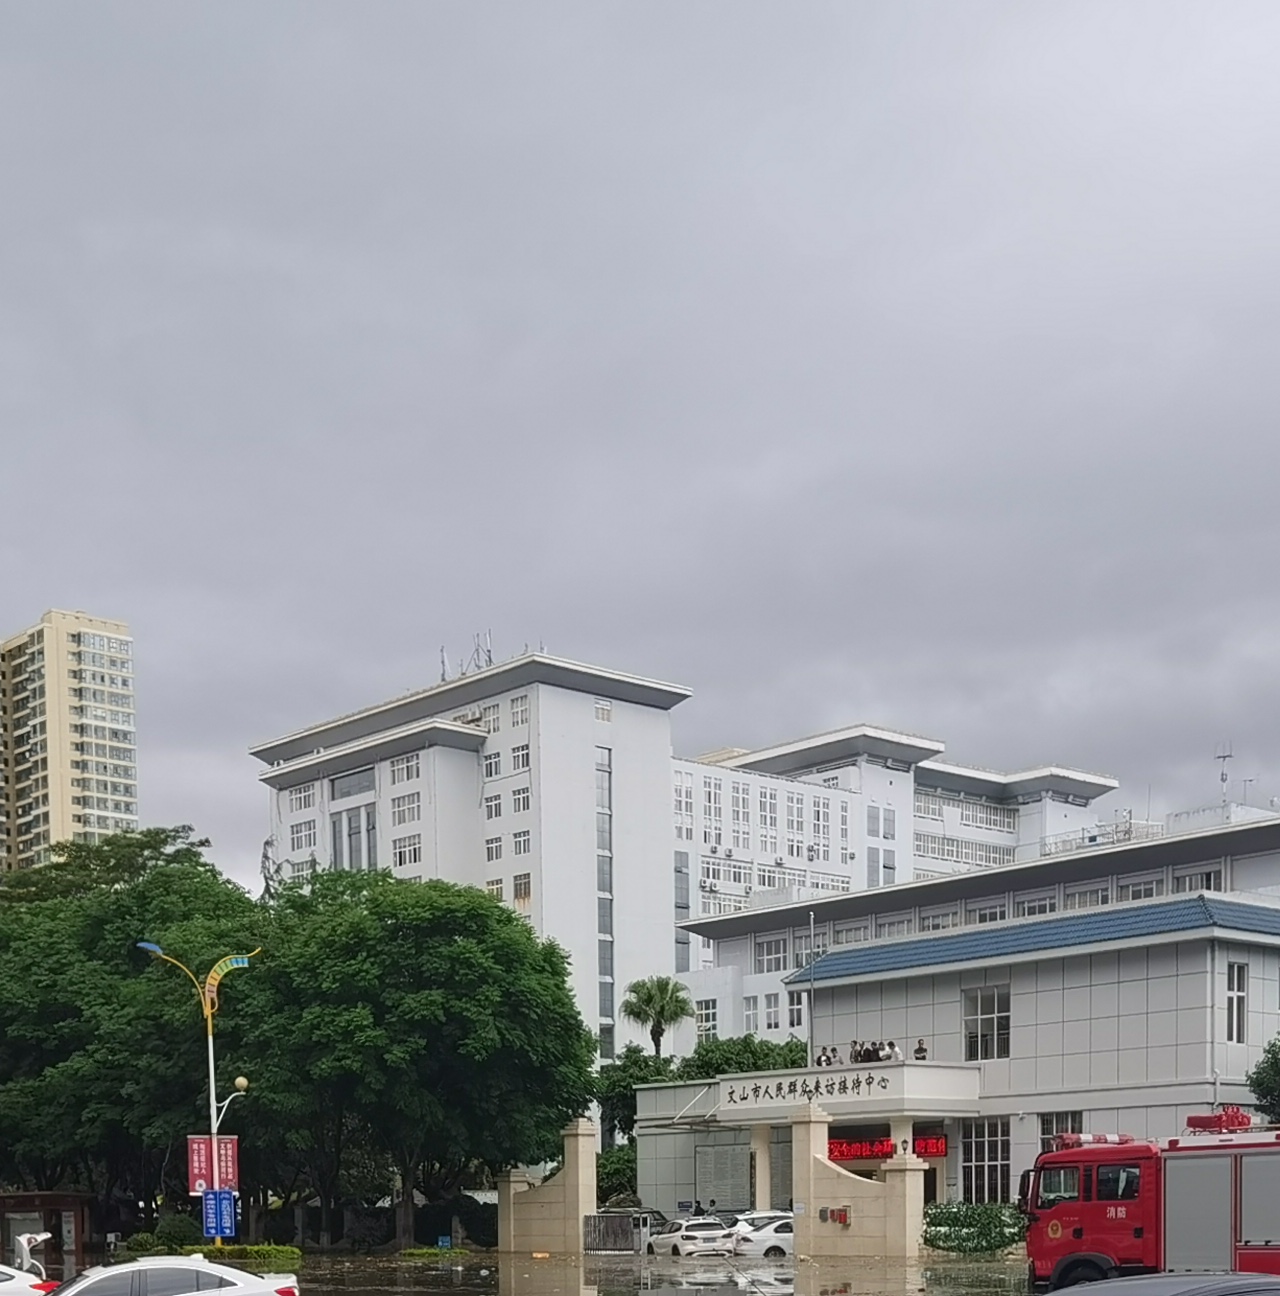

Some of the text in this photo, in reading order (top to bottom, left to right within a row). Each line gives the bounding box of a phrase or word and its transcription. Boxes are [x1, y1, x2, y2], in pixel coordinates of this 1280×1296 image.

[727, 1072, 890, 1104] 文山市人民群众来访接待中心
[1106, 1206, 1127, 1219] 消防
